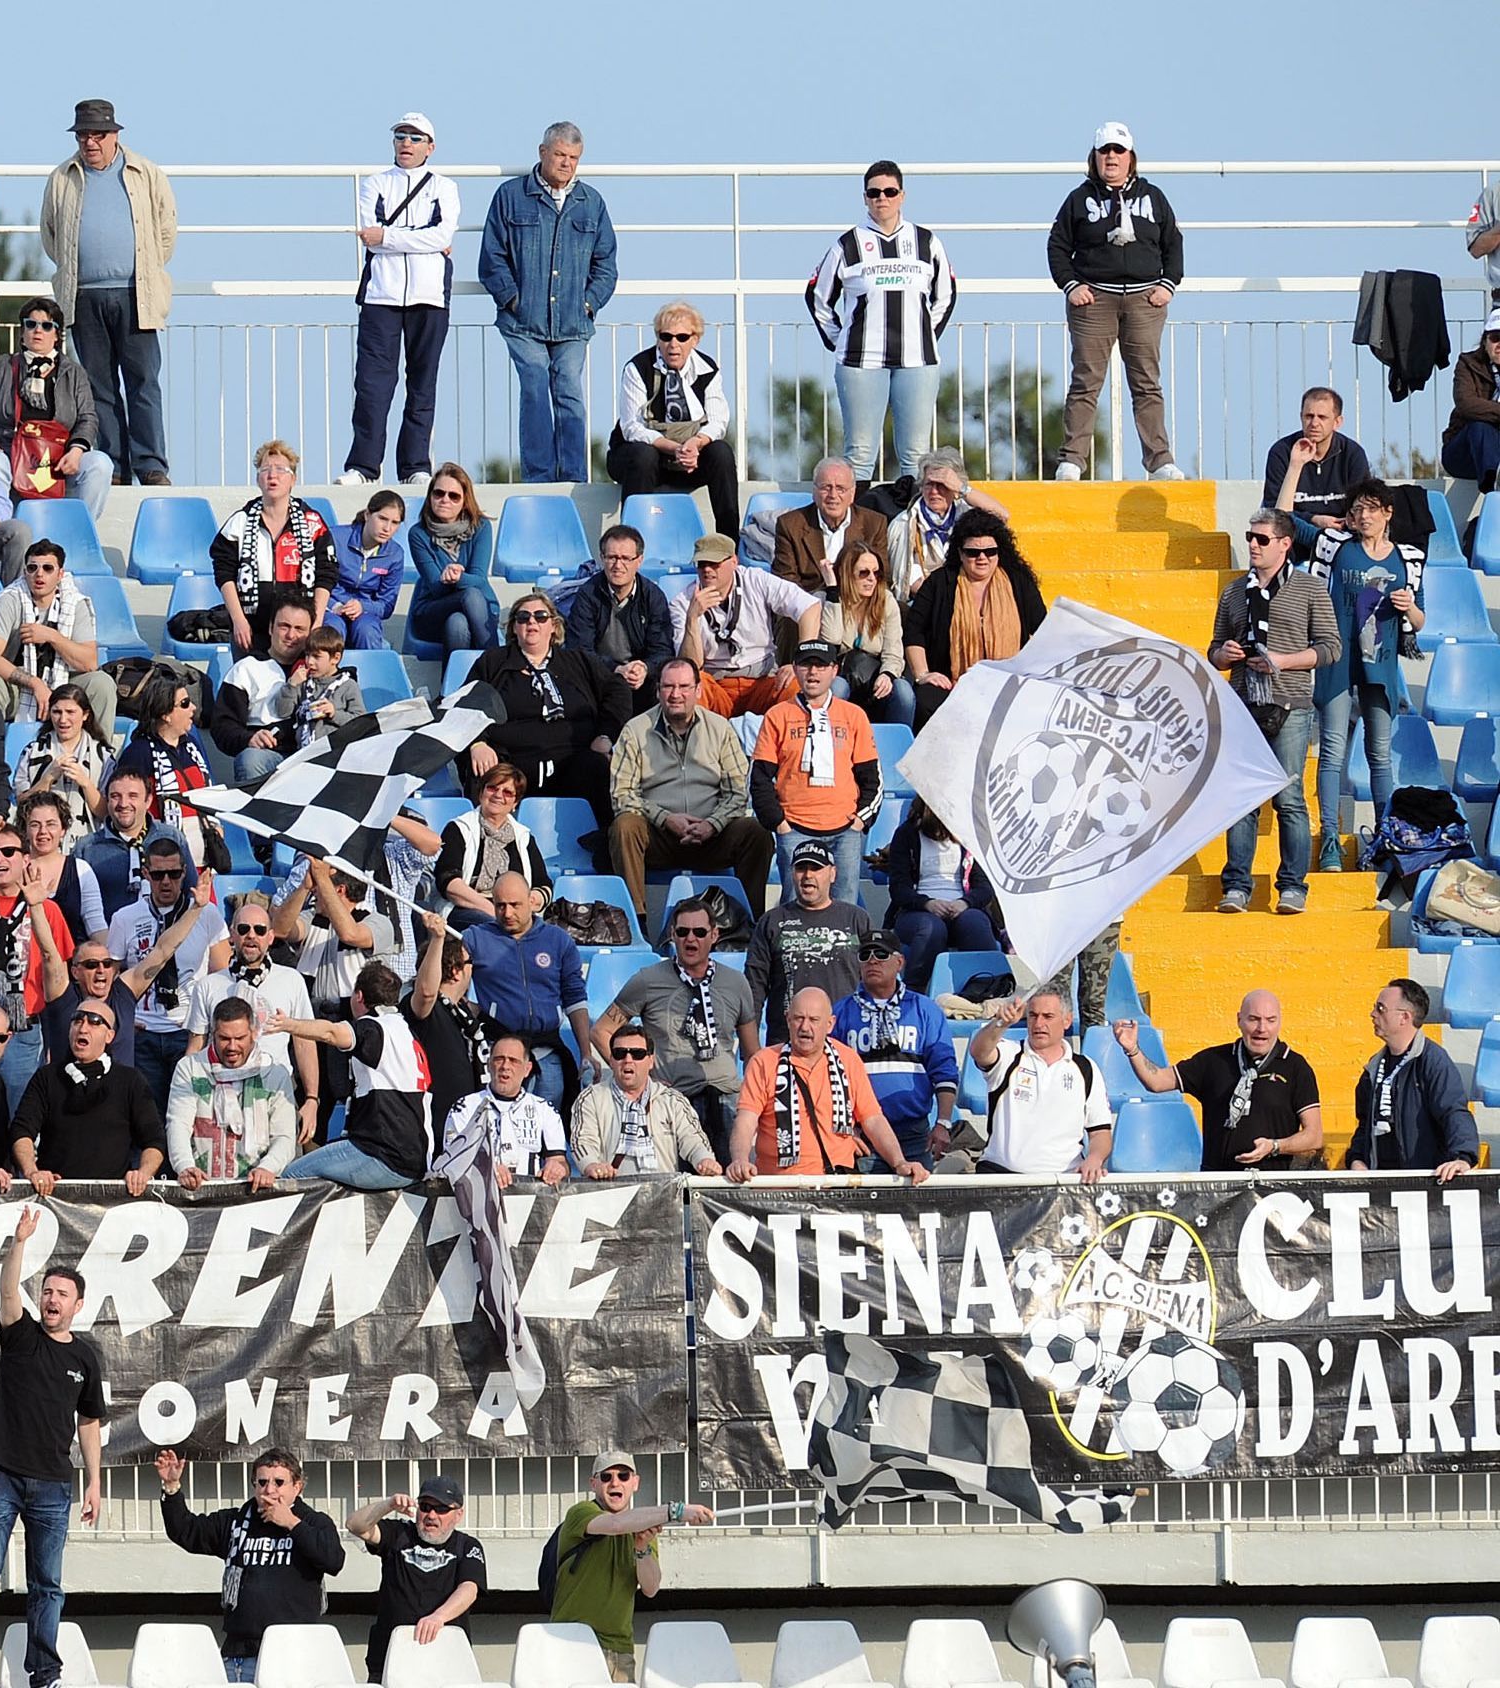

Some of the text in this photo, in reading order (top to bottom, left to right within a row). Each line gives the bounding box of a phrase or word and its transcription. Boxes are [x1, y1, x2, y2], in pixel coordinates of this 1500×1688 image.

[1085, 194, 1156, 223] SINA
[704, 1210, 1025, 1342] SIENA
[1238, 1188, 1500, 1322] CLU
